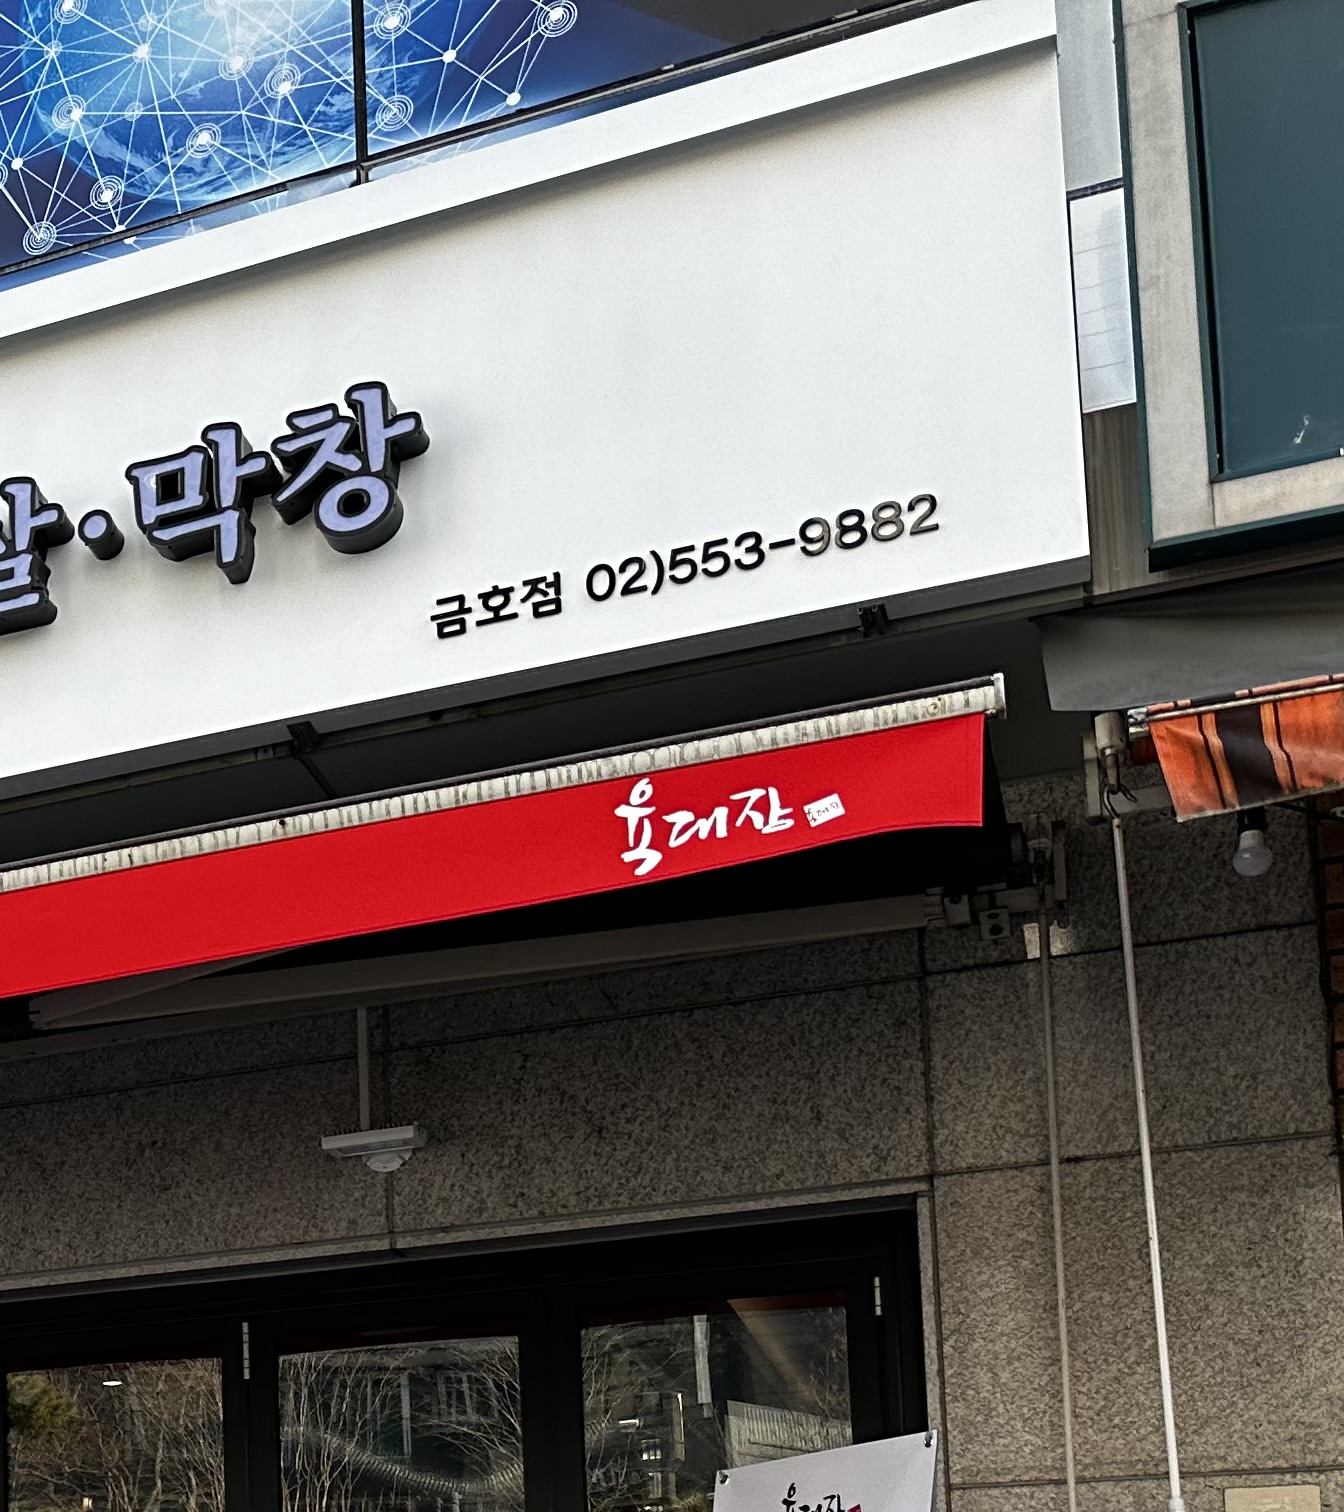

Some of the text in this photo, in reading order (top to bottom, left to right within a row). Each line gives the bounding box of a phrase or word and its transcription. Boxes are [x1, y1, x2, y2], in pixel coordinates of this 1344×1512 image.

[430, 493, 940, 638] 금호점 02)553-9882
[614, 778, 795, 876] 육대장
